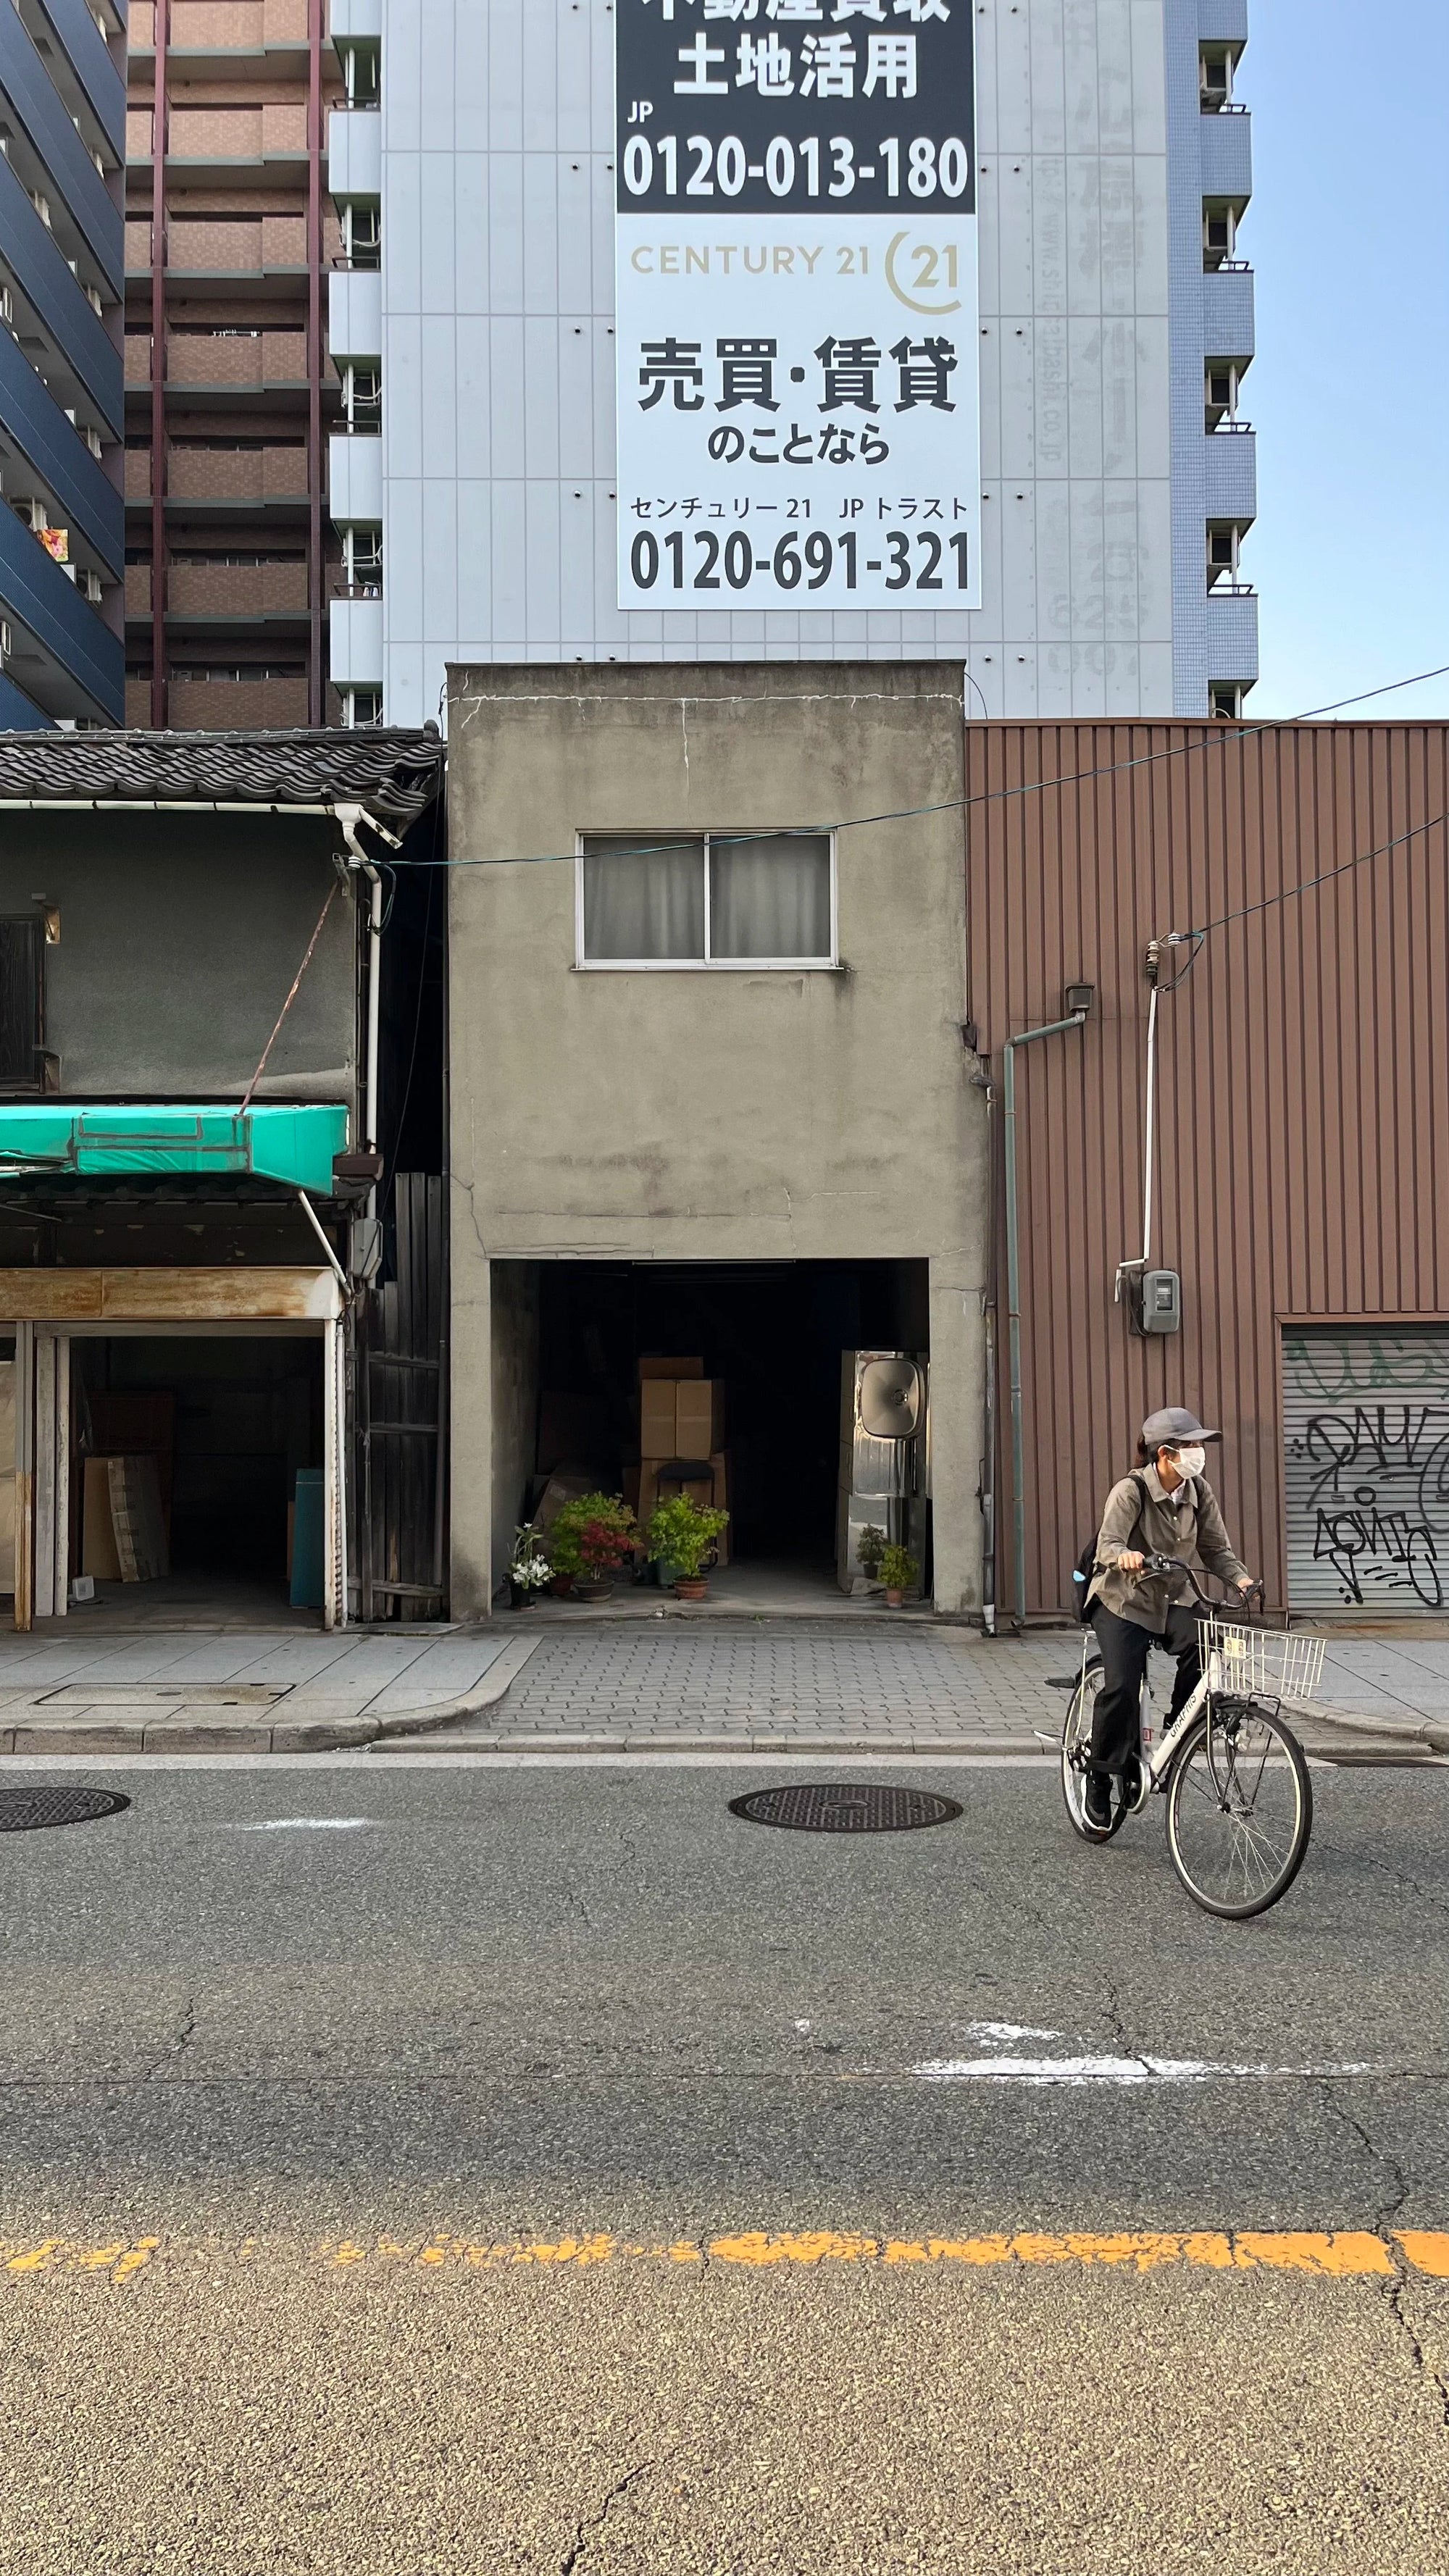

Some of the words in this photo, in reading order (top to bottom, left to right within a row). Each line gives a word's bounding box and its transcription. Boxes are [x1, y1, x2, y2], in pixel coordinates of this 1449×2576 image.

[674, 32, 917, 99] 土地活用
[627, 101, 653, 123] JP
[624, 135, 968, 198] 0120-013-180
[631, 246, 824, 275] CENTURY
[836, 246, 868, 275] 21
[638, 335, 959, 414] 売買・賃貸
[708, 422, 890, 465] のことなら
[630, 530, 968, 590] 0120-691-321
